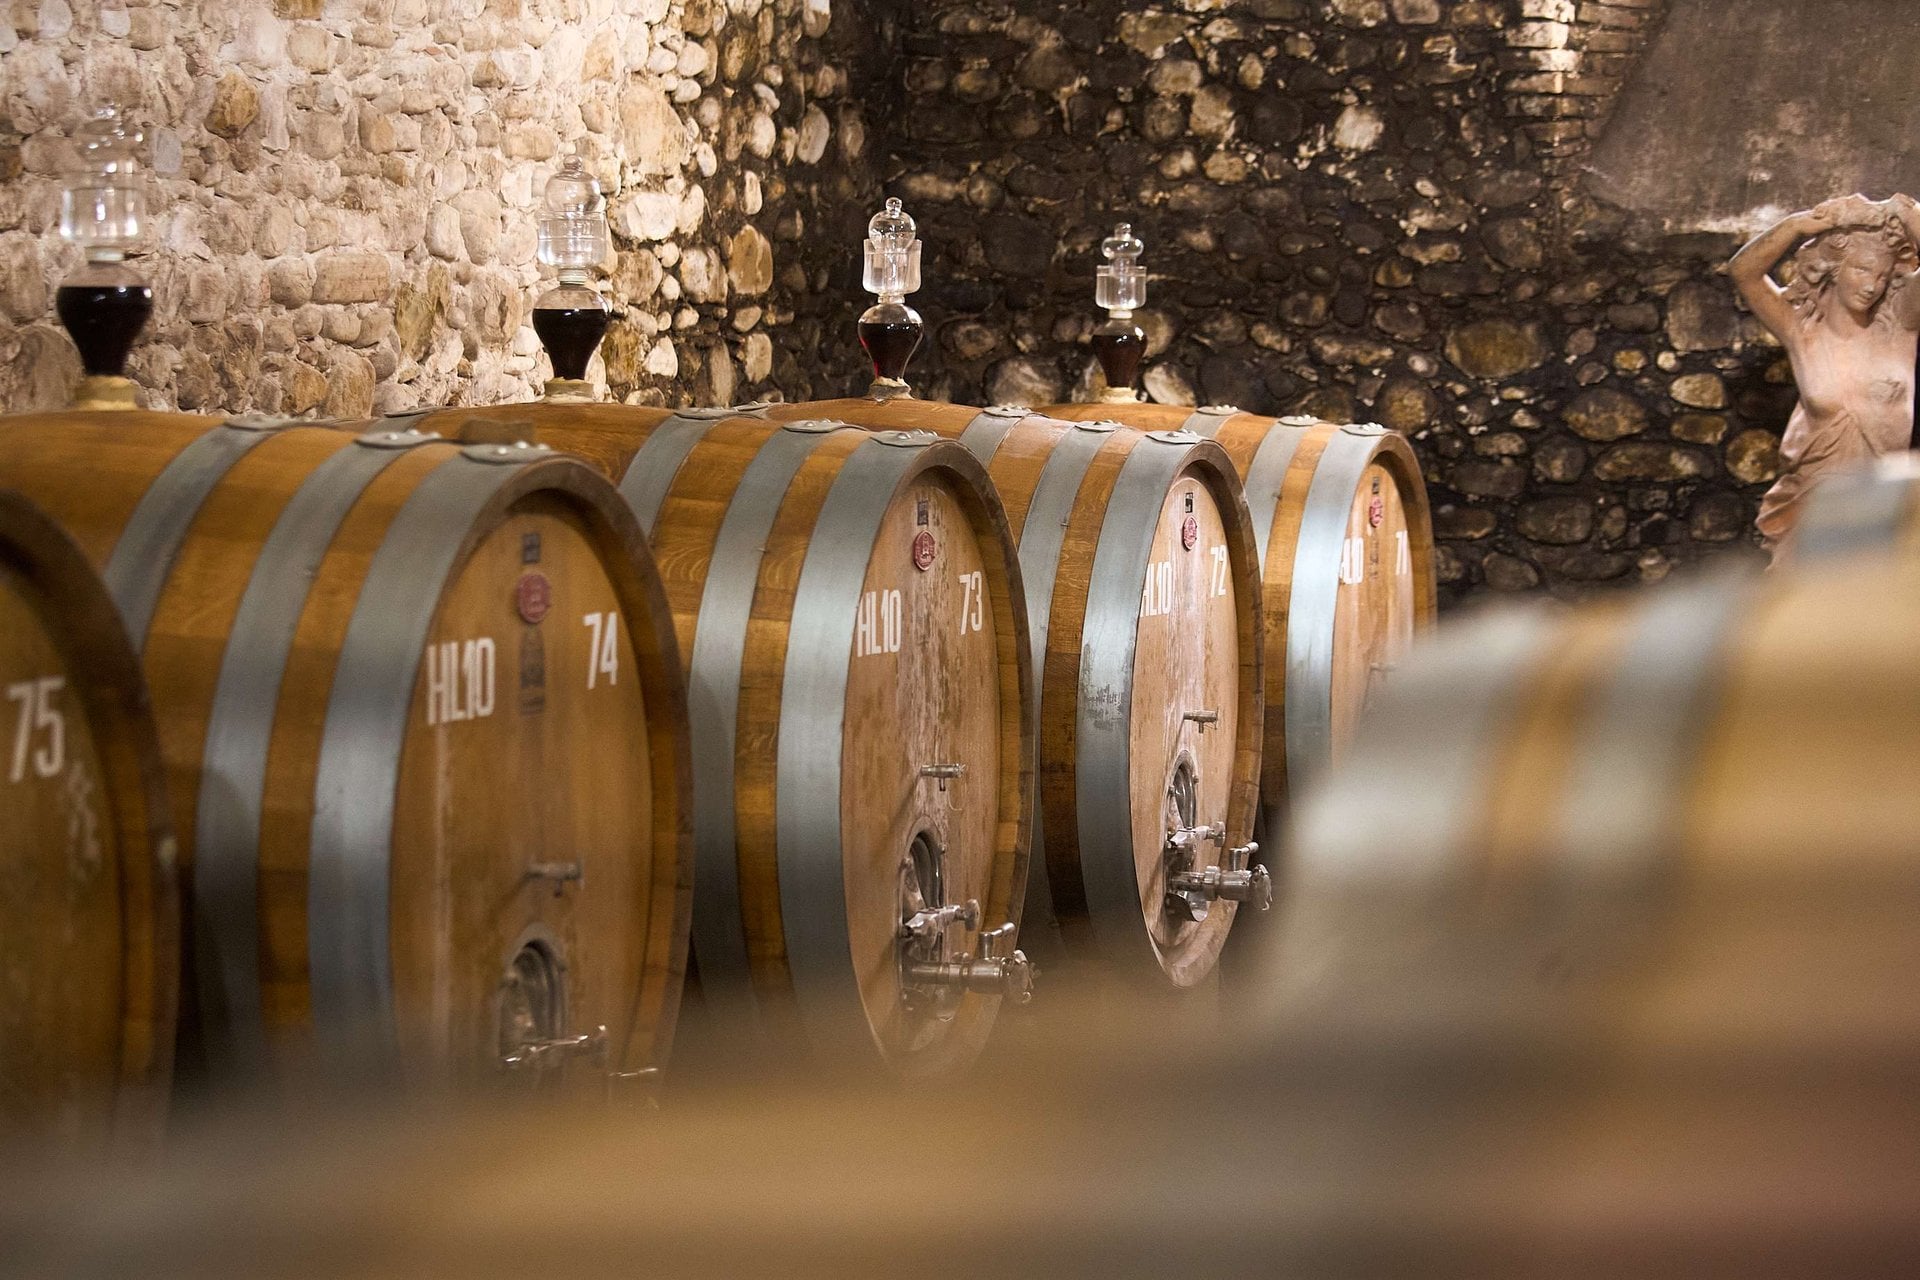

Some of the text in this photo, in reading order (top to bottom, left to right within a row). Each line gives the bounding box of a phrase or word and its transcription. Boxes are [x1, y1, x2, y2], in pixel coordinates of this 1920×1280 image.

[959, 570, 983, 636] 73
[1210, 544, 1228, 599] 72
[582, 611, 618, 690] 74
[857, 588, 902, 658] HL10
[426, 636, 496, 726] HL10
[8, 676, 66, 783] 75
